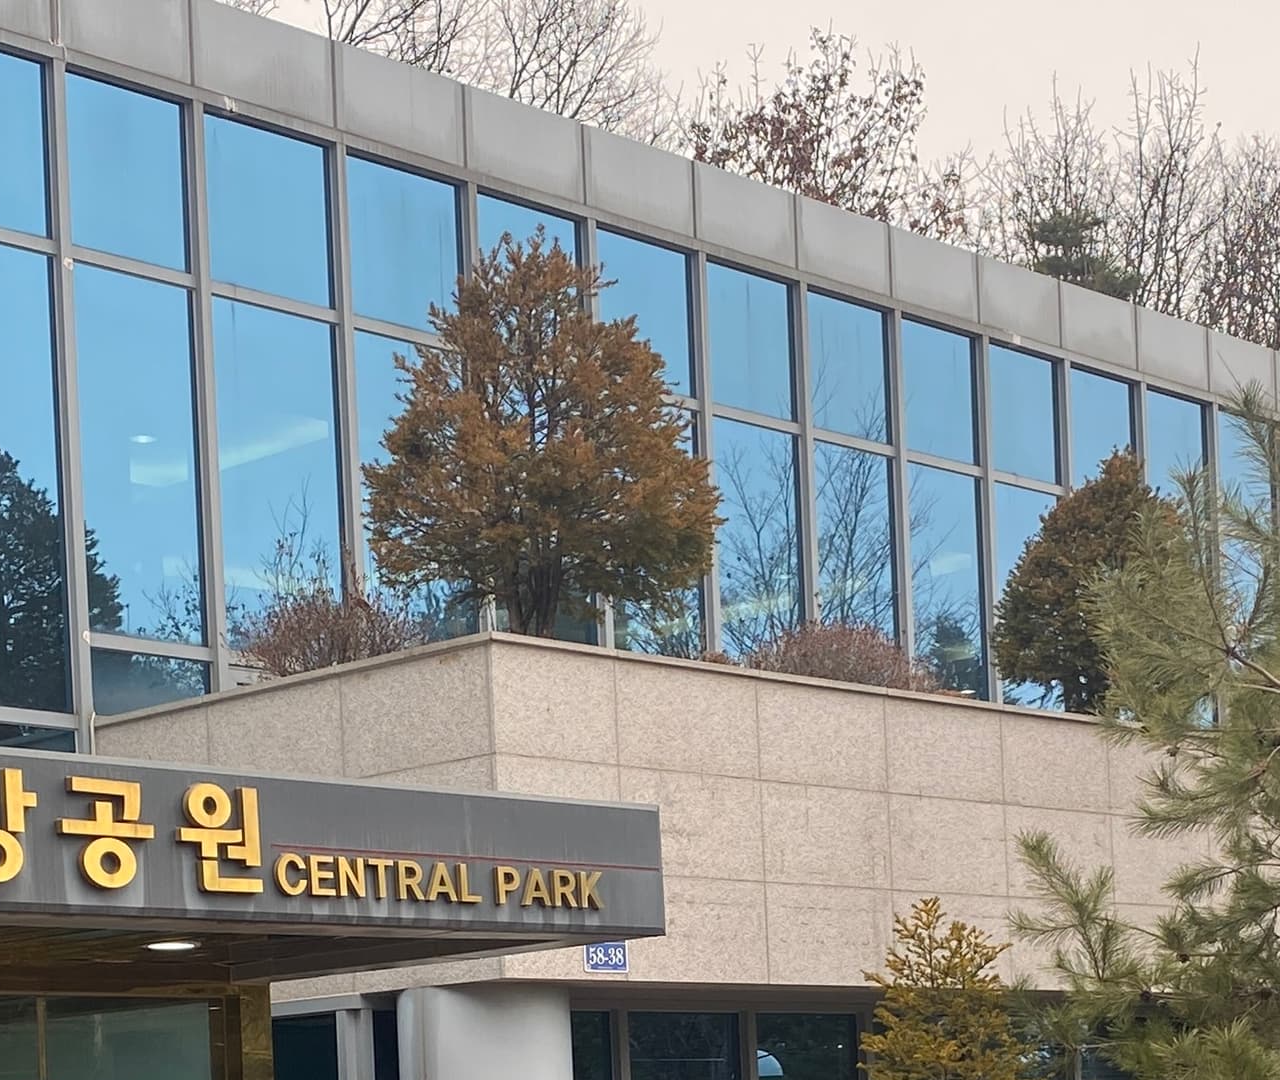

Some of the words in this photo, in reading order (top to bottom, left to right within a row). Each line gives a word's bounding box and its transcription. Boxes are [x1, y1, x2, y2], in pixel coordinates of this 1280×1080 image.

[273, 852, 483, 904] CENTRAL
[493, 865, 607, 911] PARK
[589, 947, 624, 966] 58-38
